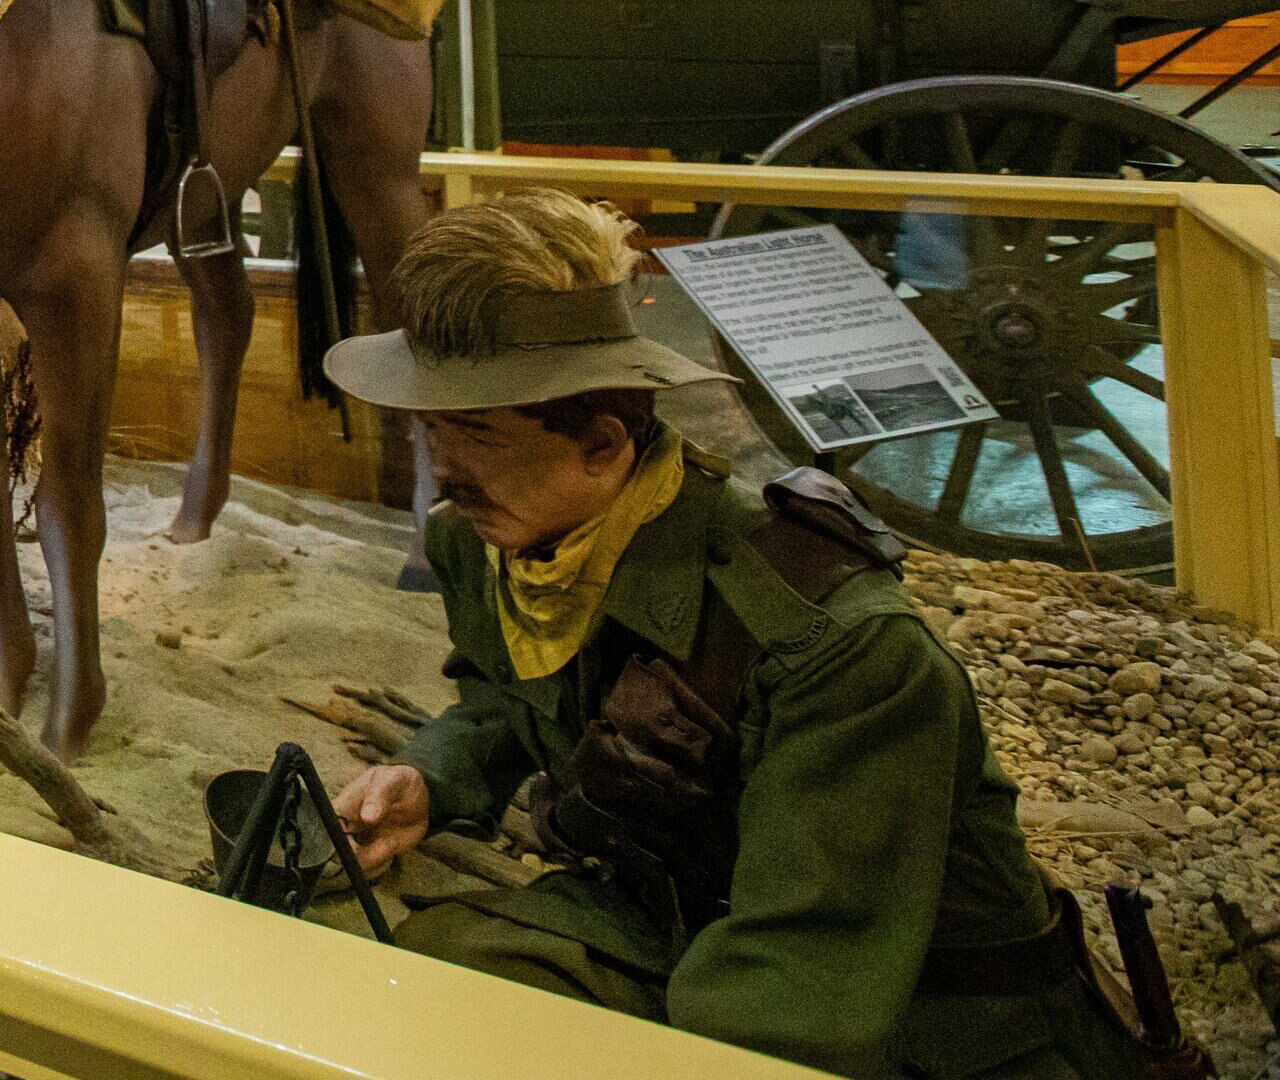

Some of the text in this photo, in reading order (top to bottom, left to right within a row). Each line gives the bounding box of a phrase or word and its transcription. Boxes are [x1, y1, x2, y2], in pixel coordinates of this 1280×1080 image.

[682, 248, 707, 261] The
[706, 241, 763, 257] Australian
[762, 236, 794, 250] Light
[789, 232, 827, 245] Horse
